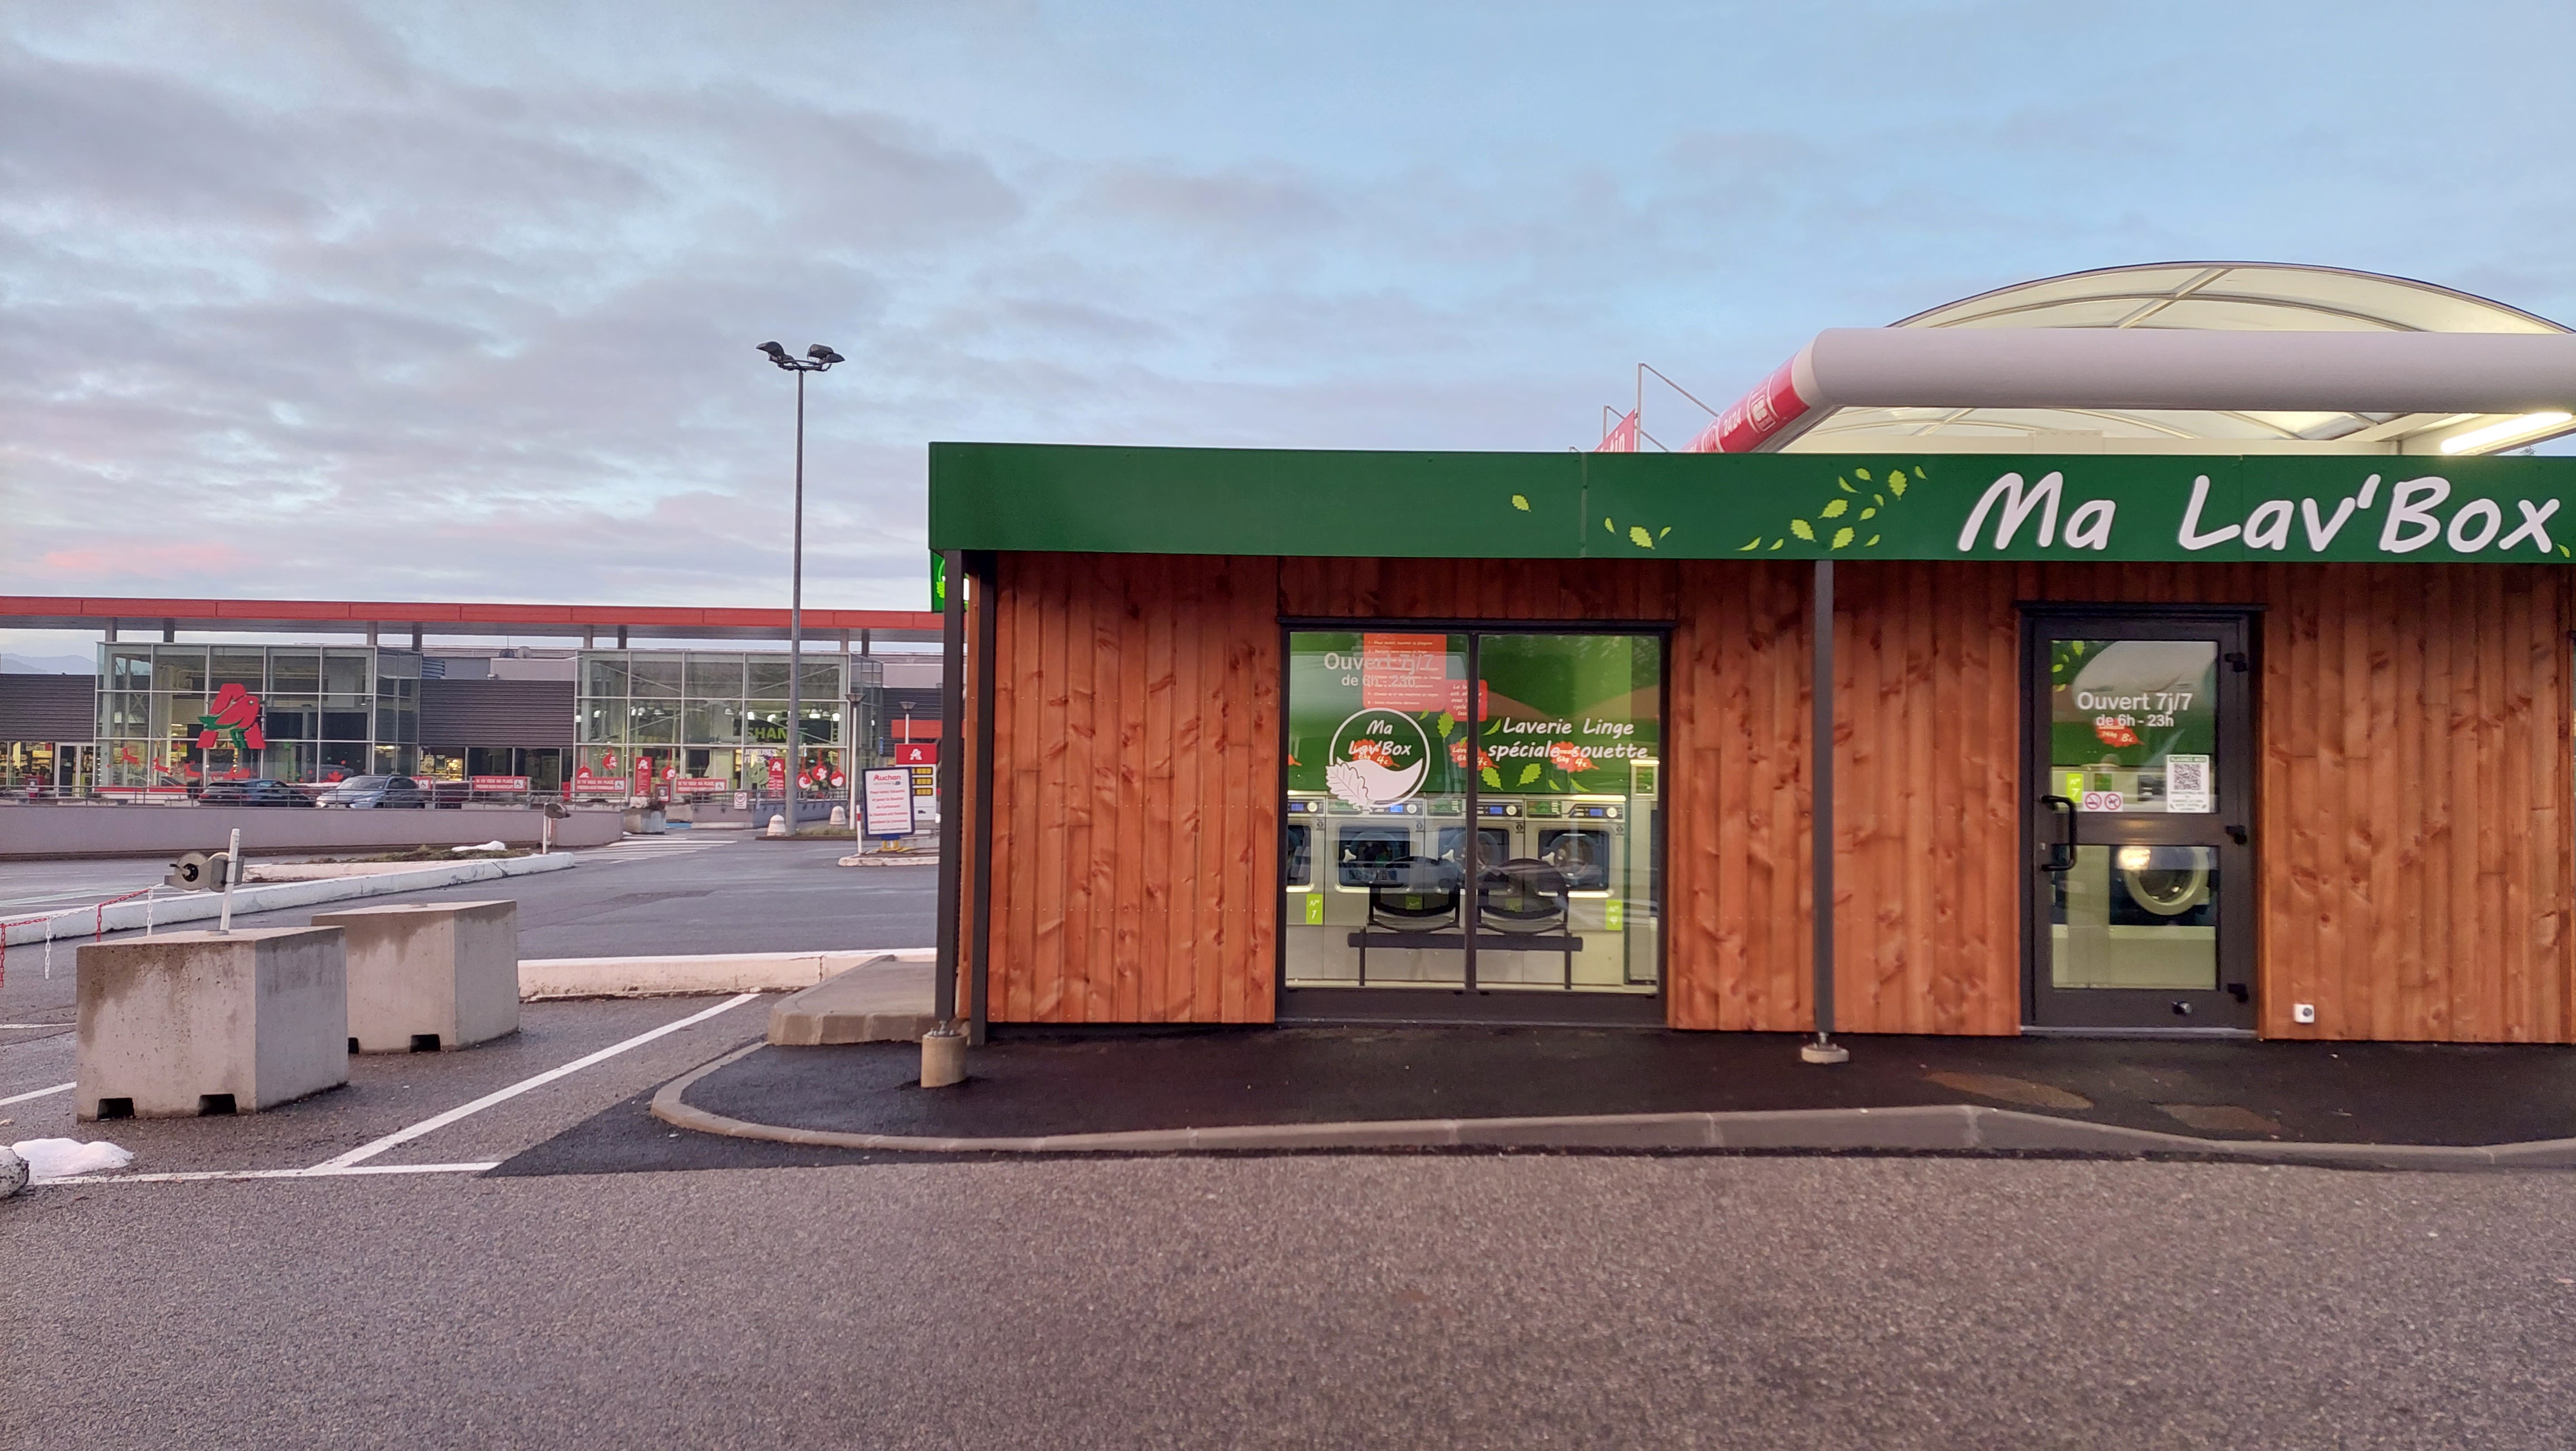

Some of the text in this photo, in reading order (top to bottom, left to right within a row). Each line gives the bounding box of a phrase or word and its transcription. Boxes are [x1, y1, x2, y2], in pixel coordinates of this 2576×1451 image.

[1958, 471, 2560, 553] Ma Lav'Box
[1324, 652, 1434, 675] Ouvert 7j/7
[1341, 674, 1358, 686] de
[1363, 675, 1378, 686] 6h
[2078, 692, 2193, 715] Ouvert 7j/7
[1366, 719, 1393, 735] Ma
[1503, 717, 1634, 739] Laverie Linge
[2096, 714, 2114, 726] de
[2118, 714, 2135, 726] 6h
[2148, 714, 2174, 727] 23h
[1348, 740, 1412, 756] Lav'Box
[1487, 740, 1647, 761] spéciale couette
